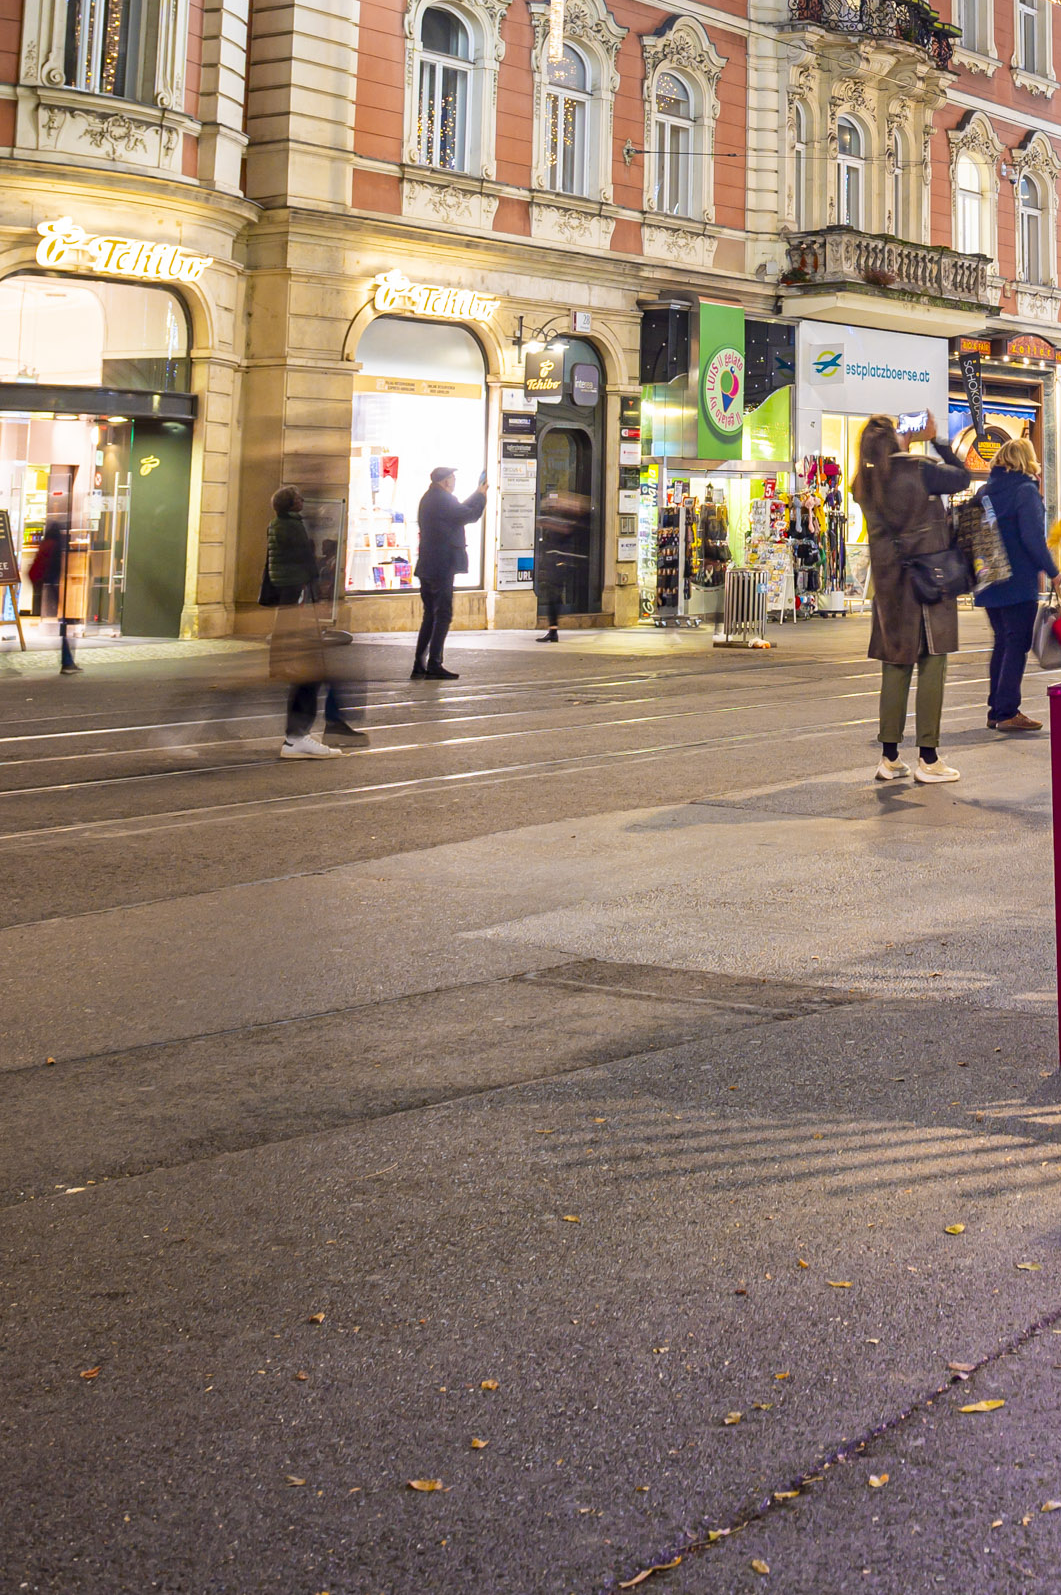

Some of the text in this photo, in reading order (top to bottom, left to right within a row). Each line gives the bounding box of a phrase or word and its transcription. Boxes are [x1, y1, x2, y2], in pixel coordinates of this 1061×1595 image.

[92, 237, 213, 281] Tchibo
[414, 285, 500, 320] Tchibo
[583, 315, 590, 325] 28
[724, 352, 744, 372] gelato
[707, 362, 719, 391] LUIS
[846, 362, 930, 383] estplatzboerse.at
[526, 378, 561, 390] Tchibo
[963, 360, 981, 421] SCHOKOL
[709, 396, 718, 411] by
[518, 570, 533, 581] URL
